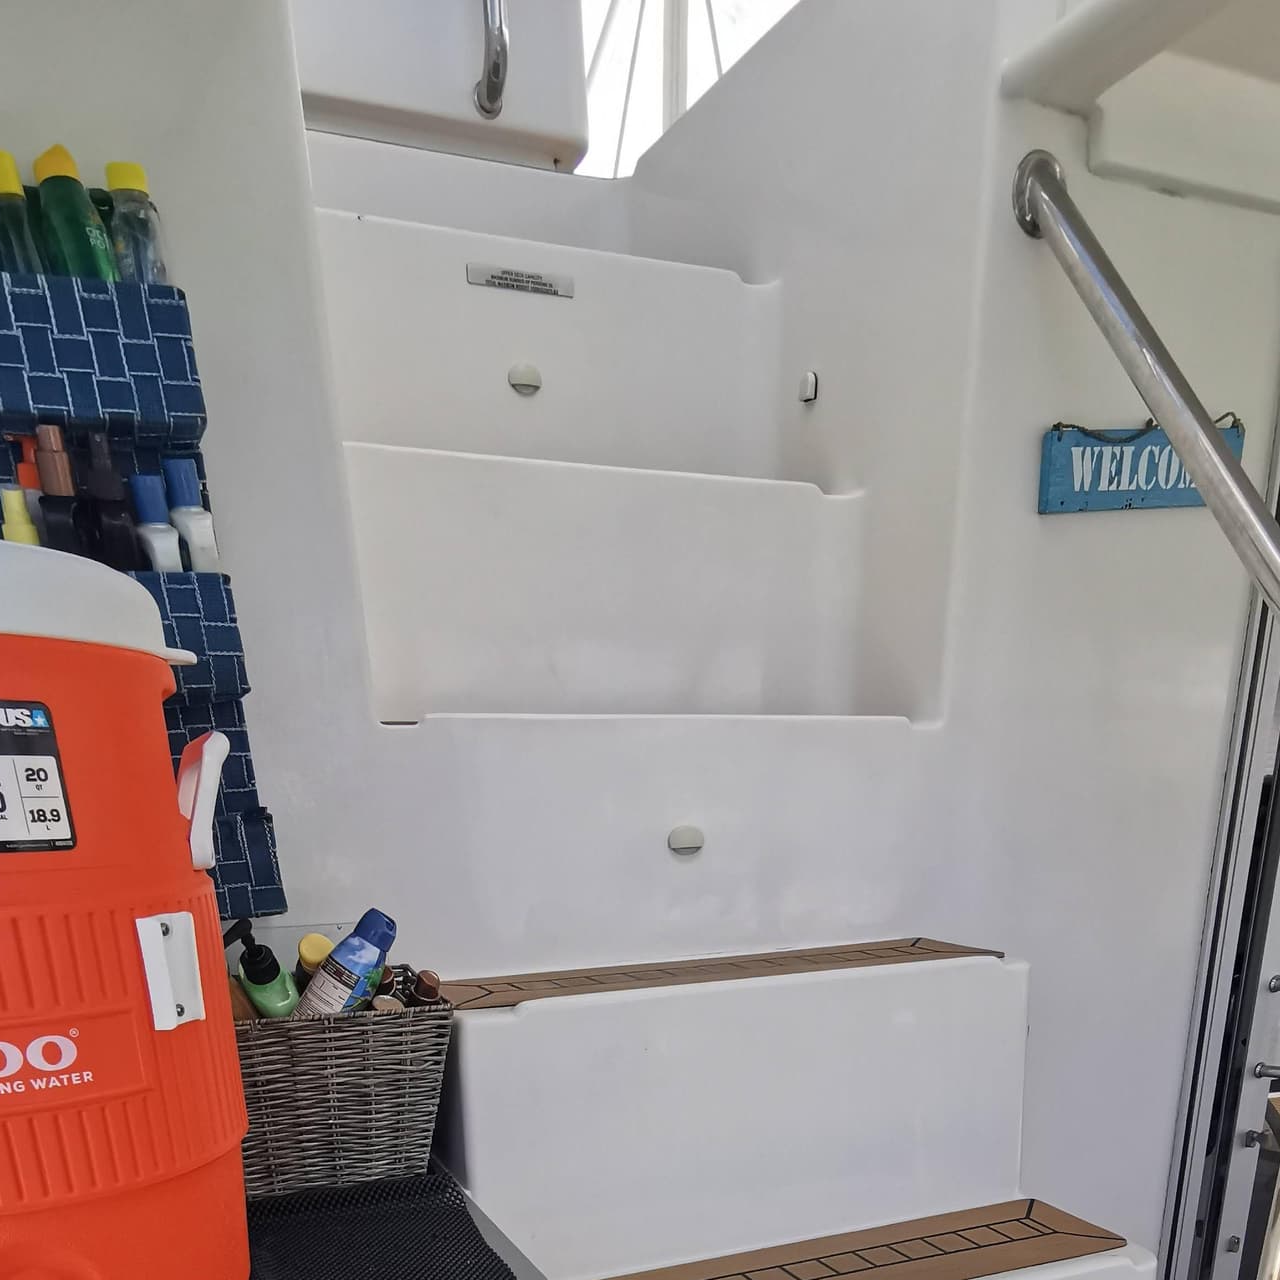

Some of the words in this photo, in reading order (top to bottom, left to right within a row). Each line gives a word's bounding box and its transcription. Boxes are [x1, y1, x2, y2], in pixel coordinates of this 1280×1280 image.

[1071, 444, 1198, 492] WELCO
[24, 767, 49, 782] 20
[29, 808, 61, 823] 18.9
[30, 1071, 95, 1090] WATER
